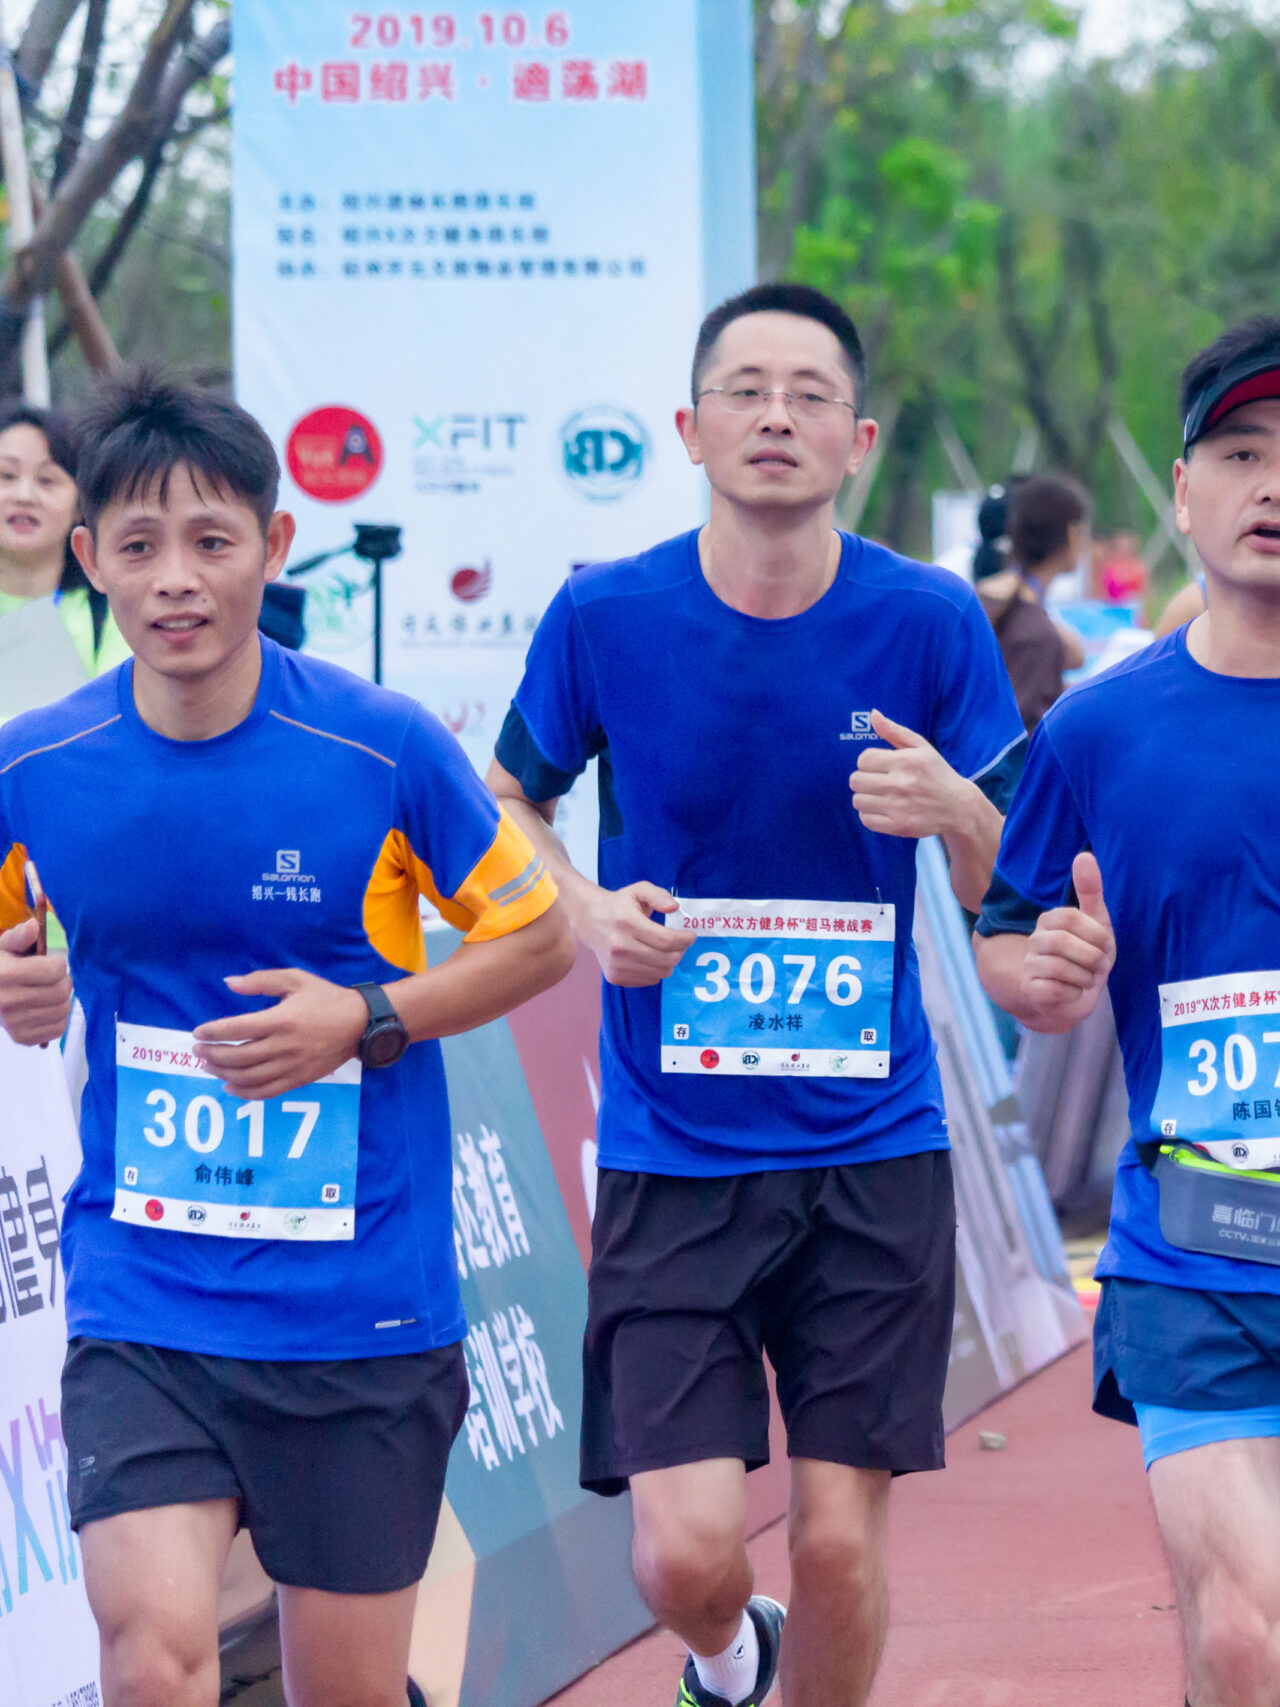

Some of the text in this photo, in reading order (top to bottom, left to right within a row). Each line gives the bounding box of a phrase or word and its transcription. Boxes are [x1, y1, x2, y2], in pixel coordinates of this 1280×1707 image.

[350, 13, 570, 47] 2019.10.6
[412, 412, 527, 450] XFIT
[693, 951, 863, 1007] 3076
[676, 1026, 688, 1038] 存
[748, 1013, 804, 1032] 凌水祥
[863, 1031, 875, 1042] 取
[143, 1088, 321, 1159] 3017
[1163, 1121, 1175, 1135] 存
[194, 1163, 255, 1187] 俞伟峰
